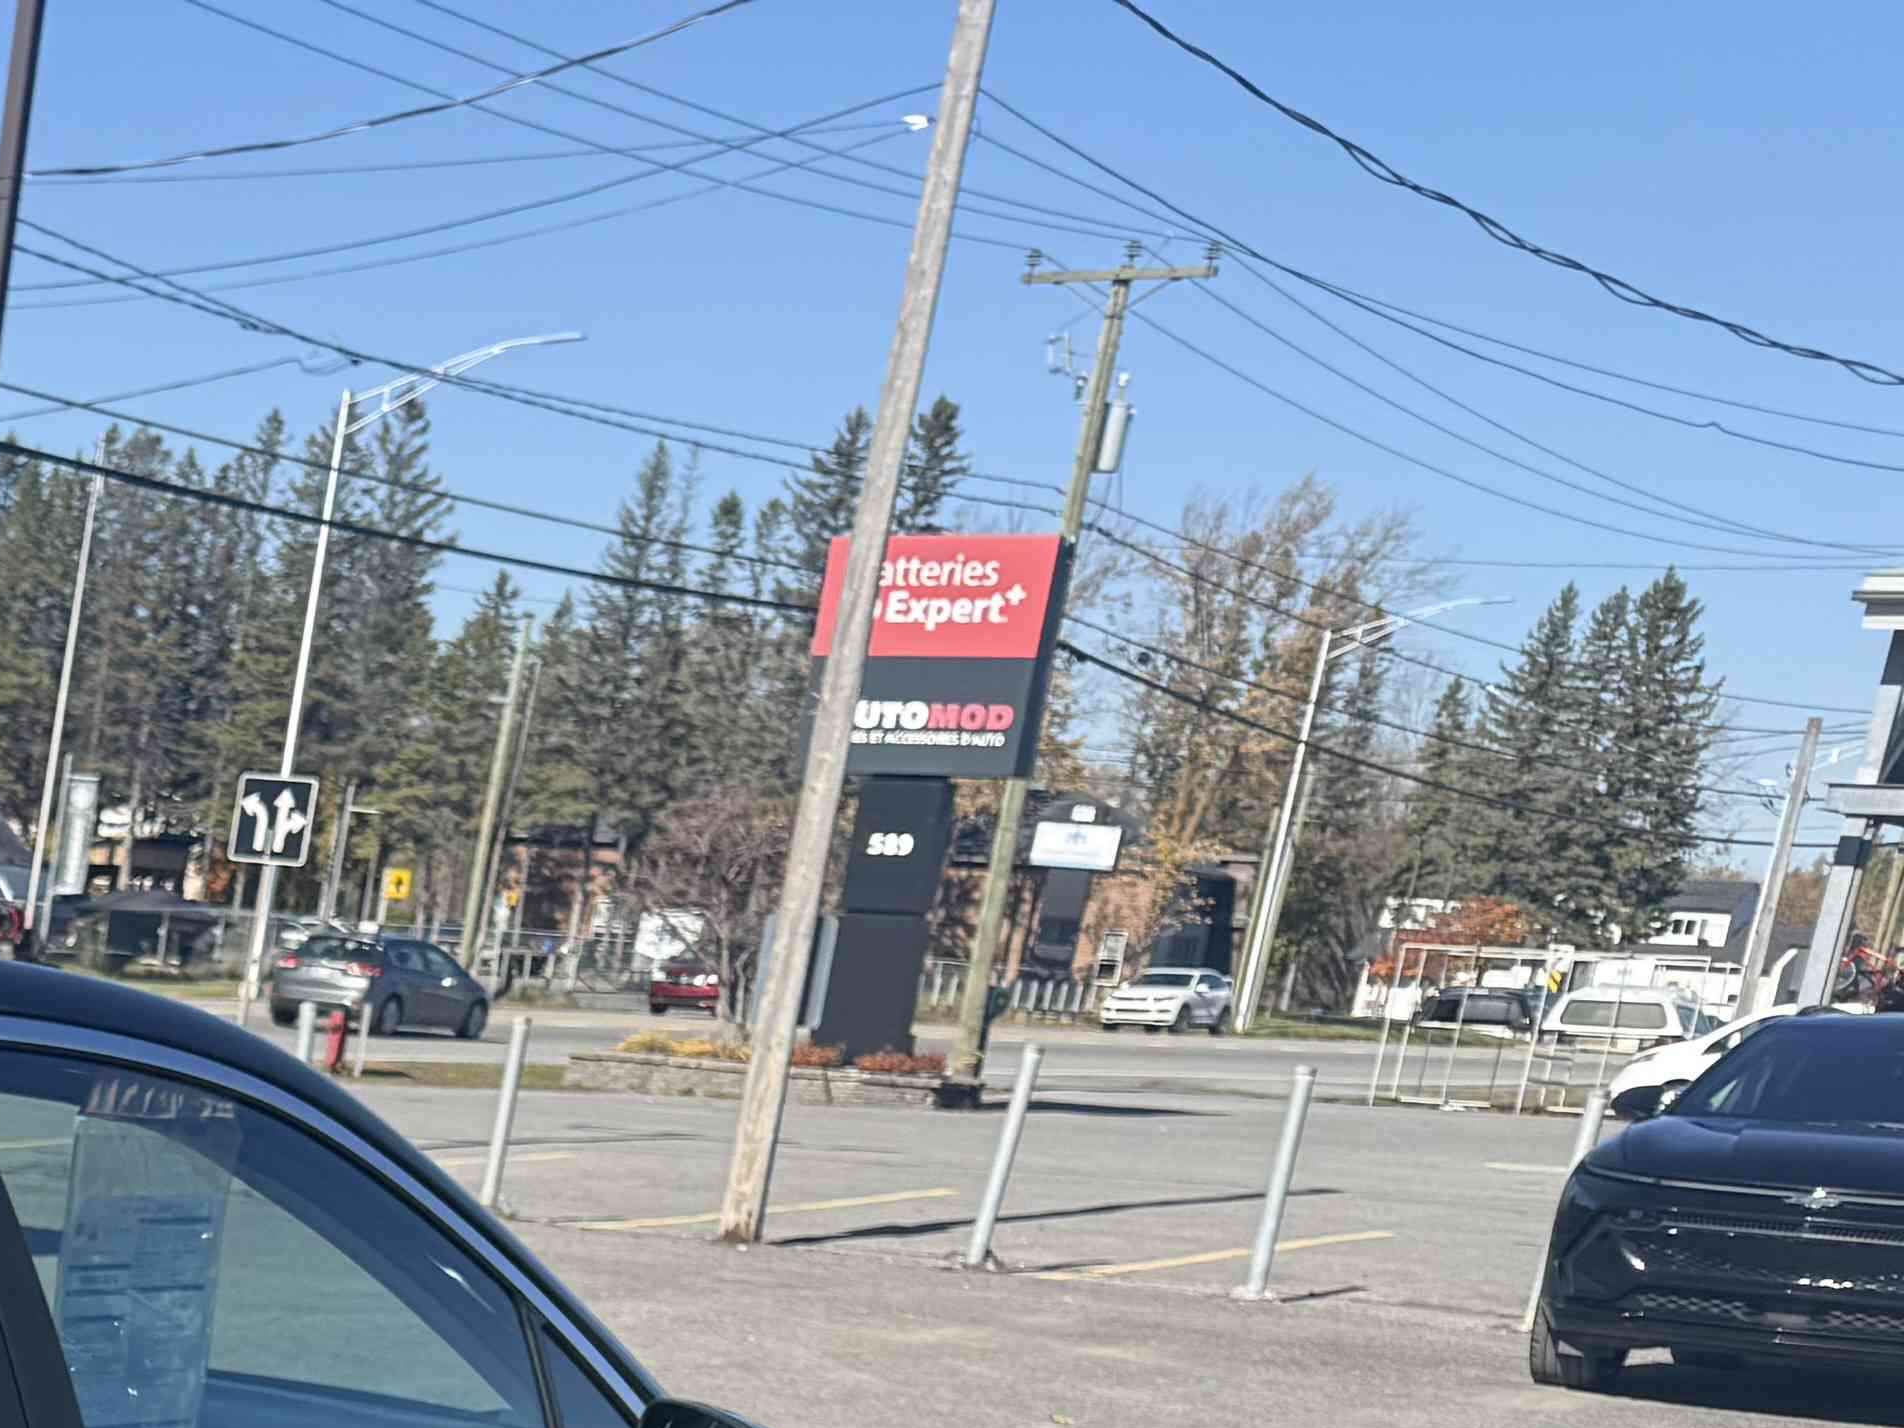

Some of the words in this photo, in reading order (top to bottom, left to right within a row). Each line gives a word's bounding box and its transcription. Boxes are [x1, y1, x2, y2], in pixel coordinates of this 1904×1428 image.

[879, 552, 1001, 587] atteries
[853, 700, 1014, 730] UTOMOD
[866, 832, 914, 856] 589
